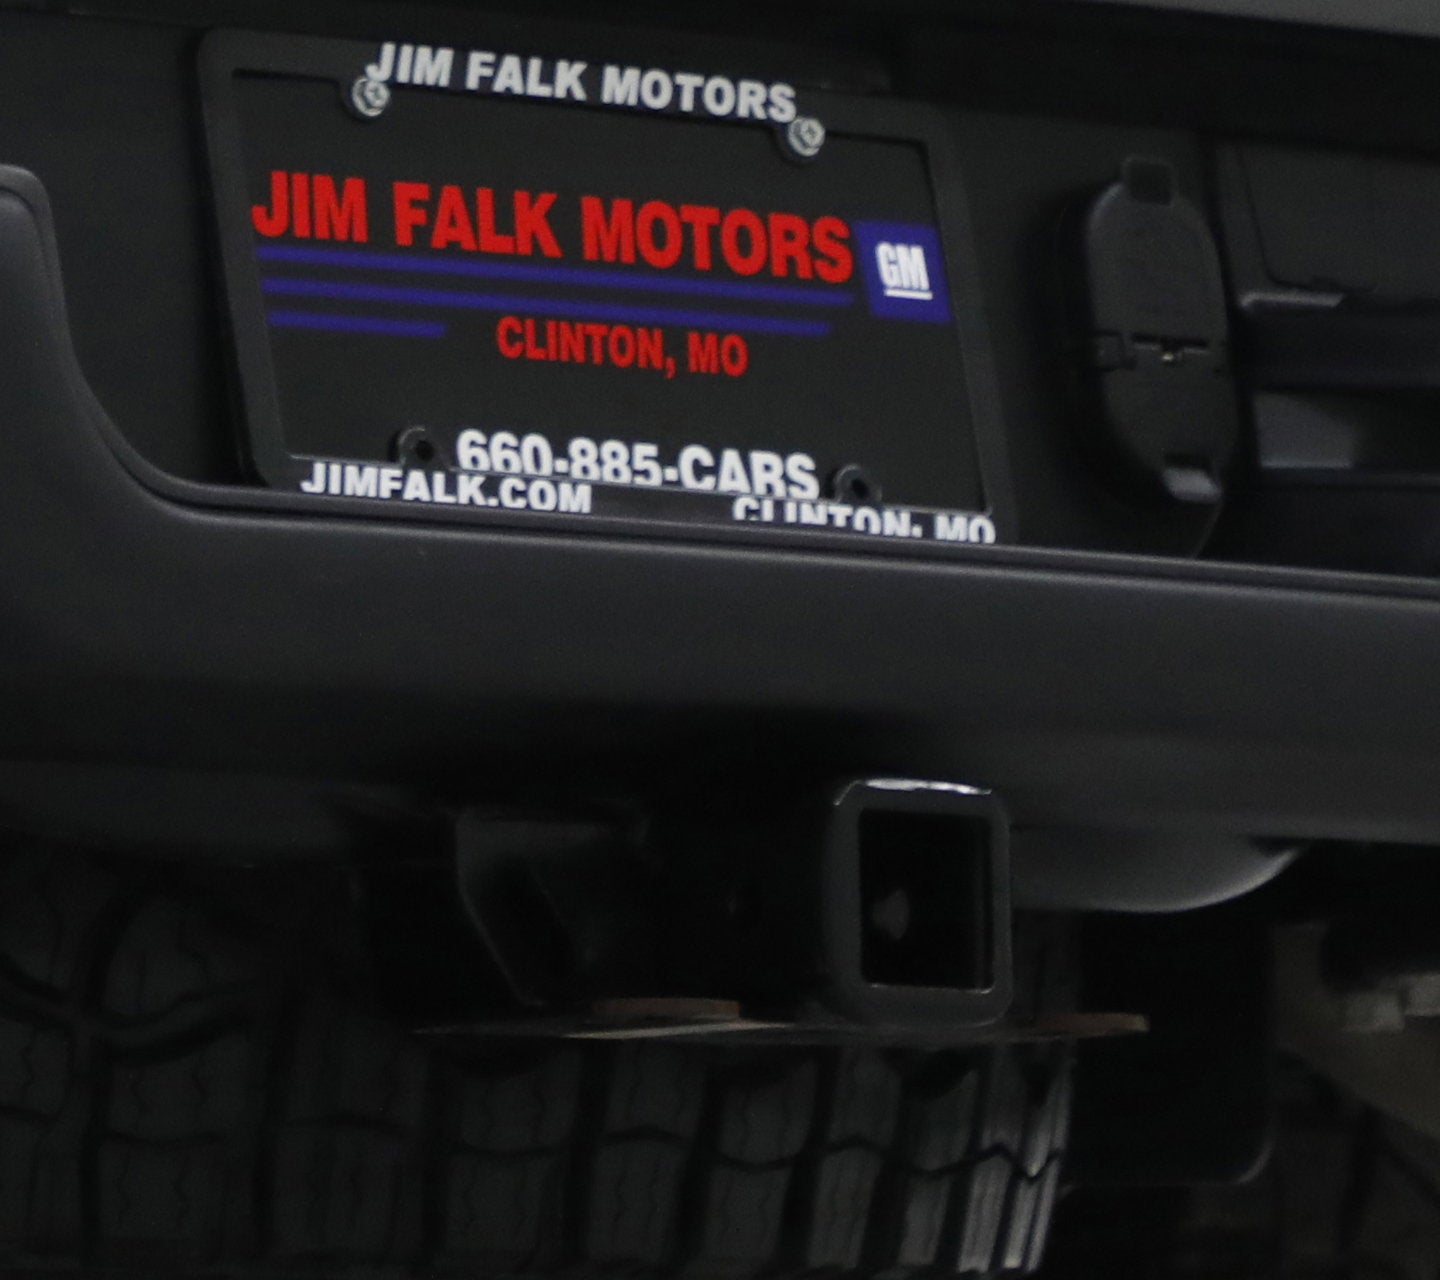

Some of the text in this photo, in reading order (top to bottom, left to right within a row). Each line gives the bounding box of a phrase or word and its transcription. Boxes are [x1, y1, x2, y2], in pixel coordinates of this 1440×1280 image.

[365, 43, 798, 124] JIM FALK MOTORS
[250, 170, 854, 283] JIM FALK MOTORS
[874, 241, 933, 293] GM
[495, 315, 749, 380] CLINTON, MO
[300, 462, 593, 514] JIMFALK.COM
[455, 429, 820, 501] 660-885-CARS
